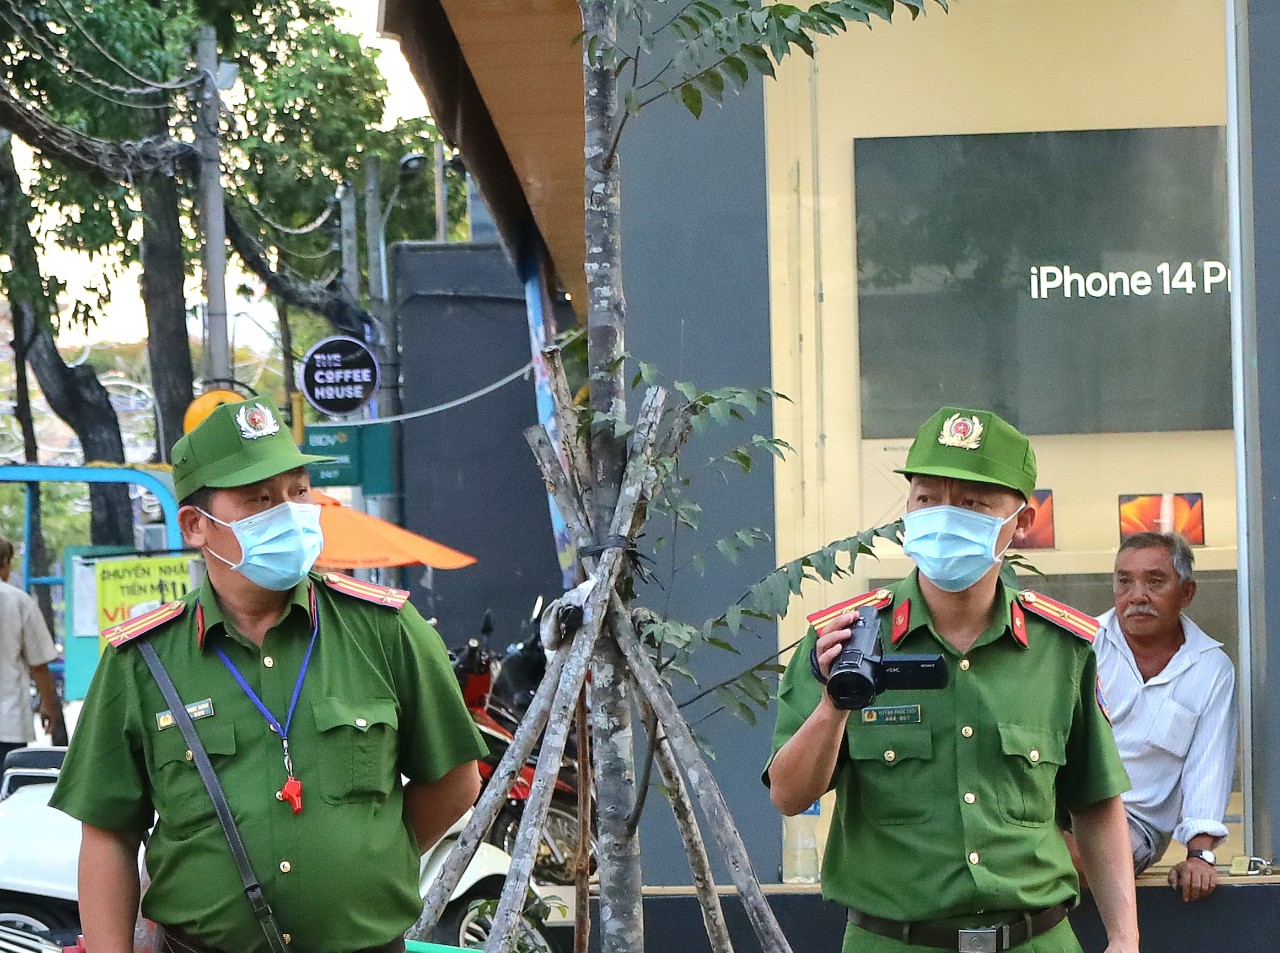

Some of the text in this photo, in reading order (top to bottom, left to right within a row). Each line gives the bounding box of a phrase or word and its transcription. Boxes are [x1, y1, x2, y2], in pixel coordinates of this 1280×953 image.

[1030, 264, 1153, 299] iPhone
[1156, 261, 1197, 296] 14
[313, 353, 342, 367] THE
[313, 368, 372, 384] COFFEE
[313, 385, 364, 400] HOUSE
